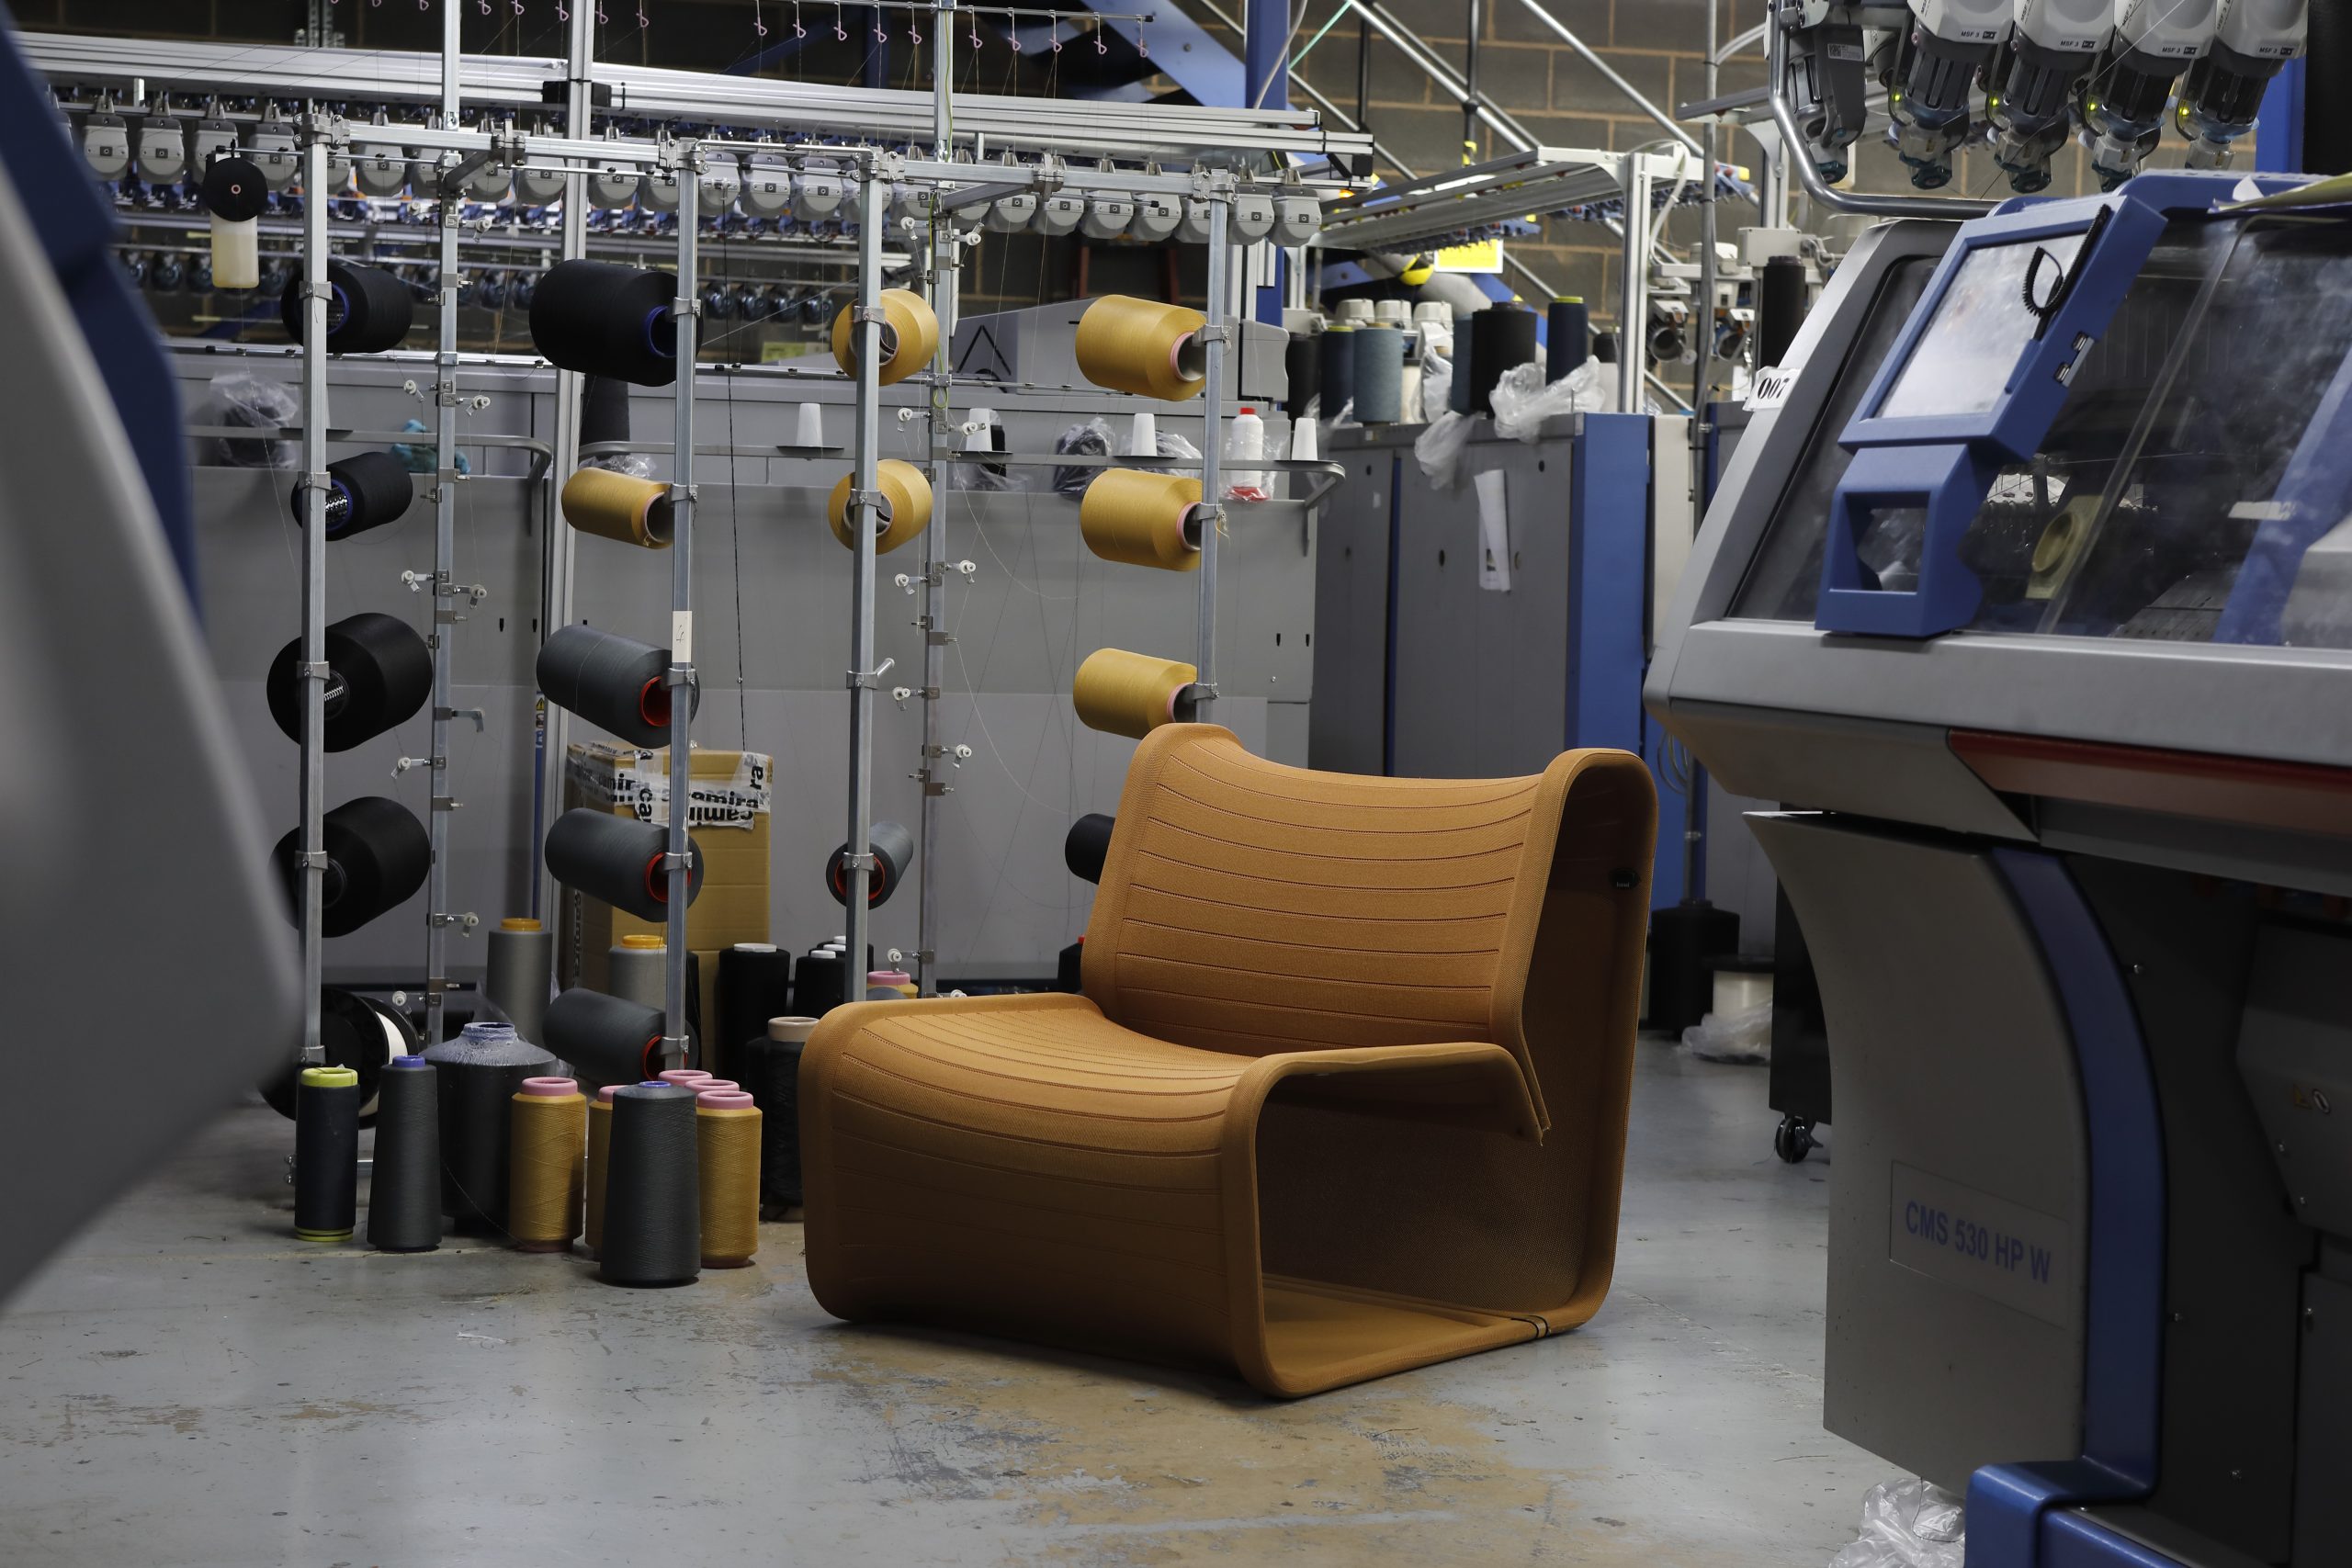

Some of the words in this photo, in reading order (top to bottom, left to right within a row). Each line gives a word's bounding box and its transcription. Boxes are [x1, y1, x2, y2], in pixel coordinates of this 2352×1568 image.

[1758, 378, 1790, 399] 007
[689, 790, 759, 809] amira
[1905, 1201, 1949, 1246] CMS
[1954, 1218, 1988, 1261] 530
[1995, 1233, 2024, 1271] HP
[2029, 1245, 2052, 1284] W
